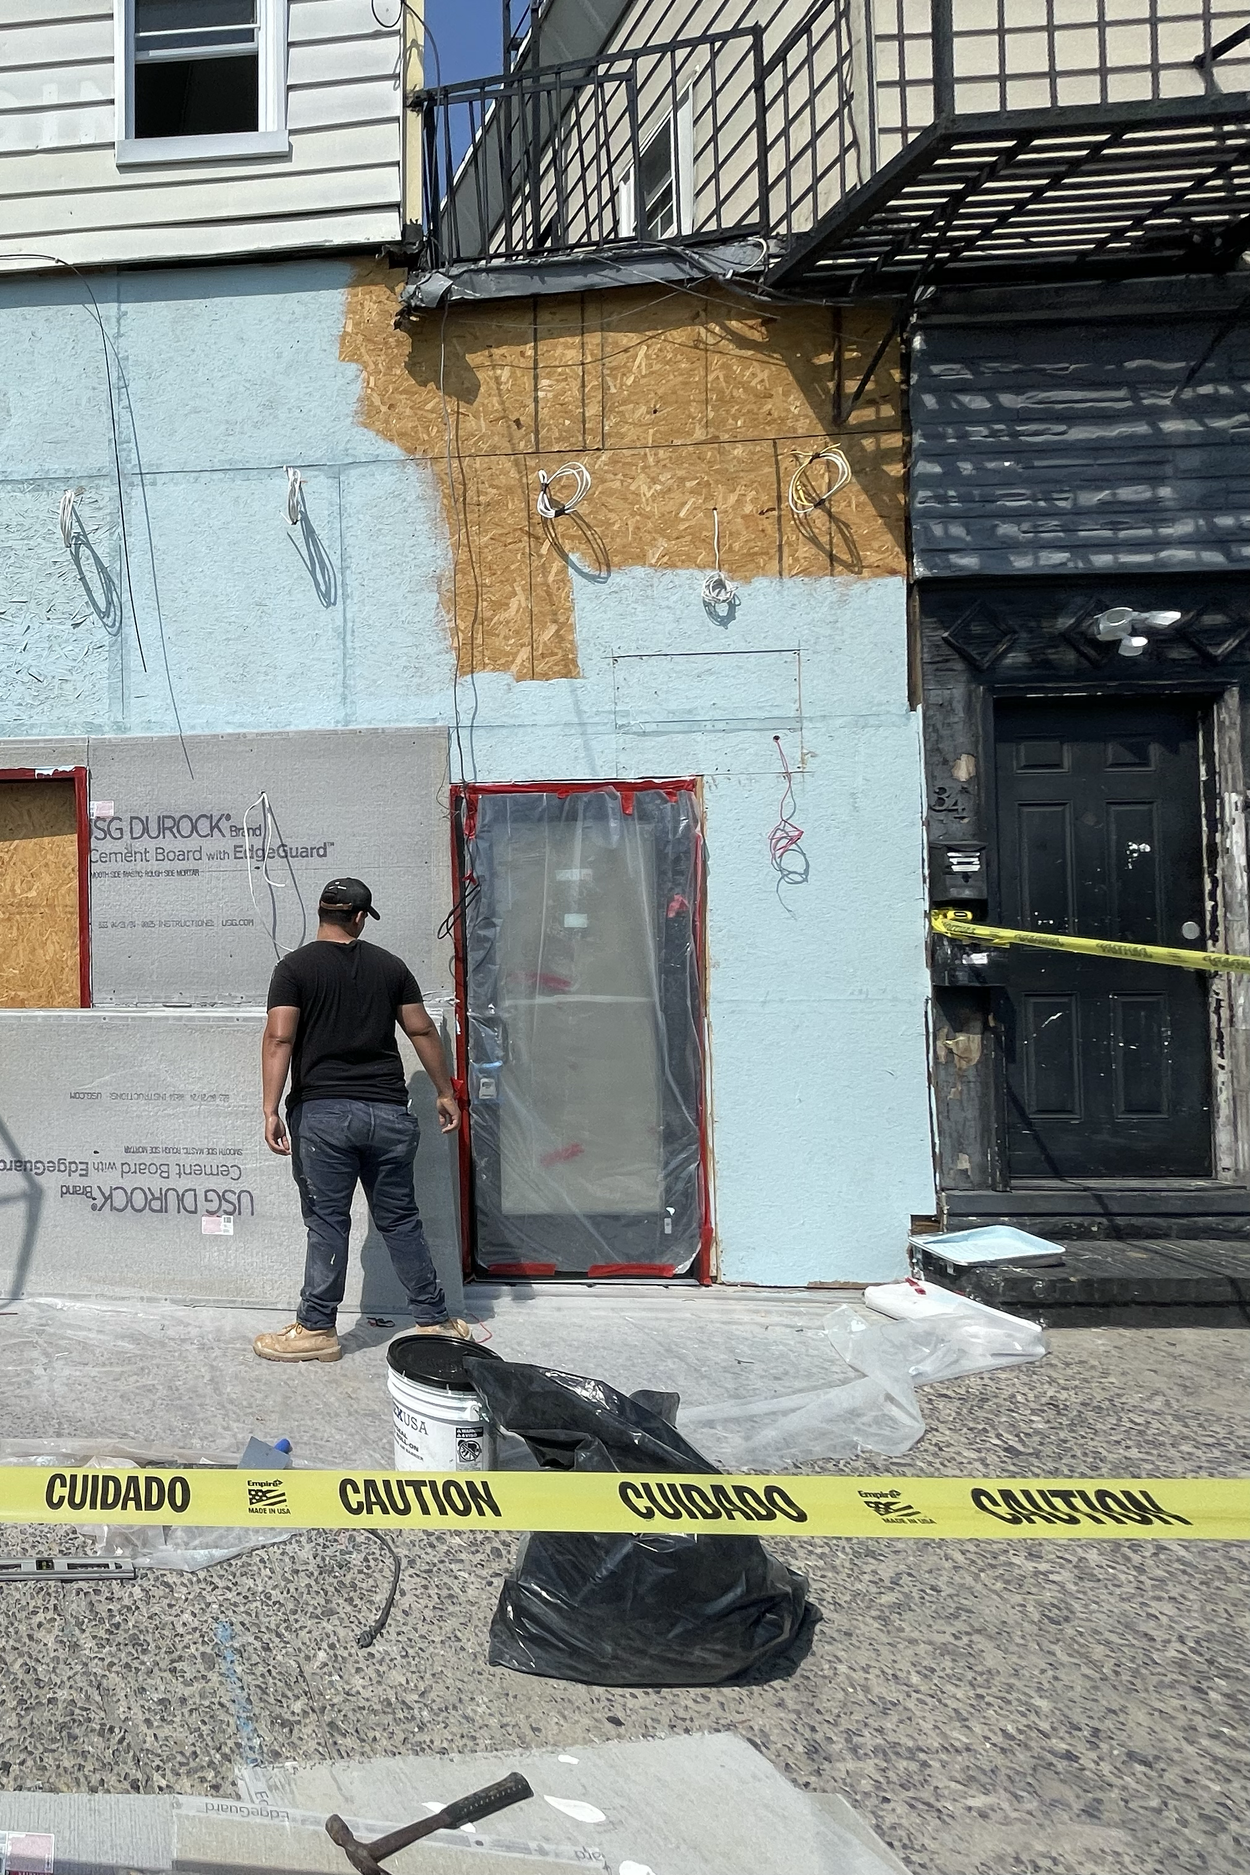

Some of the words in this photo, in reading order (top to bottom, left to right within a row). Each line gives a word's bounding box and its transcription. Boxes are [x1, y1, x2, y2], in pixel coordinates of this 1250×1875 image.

[89, 815, 124, 841] SG
[230, 824, 262, 838] Brand
[155, 845, 202, 862] Board
[206, 850, 230, 861] with
[92, 1161, 118, 1173] with
[120, 1161, 170, 1179] Board
[175, 1163, 242, 1181] Cement
[60, 1184, 93, 1199] Brand
[204, 1188, 255, 1216] USG
[45, 1473, 191, 1513] CUIDADO
[338, 1478, 503, 1517] CAUTION
[617, 1480, 808, 1523] CUIDADO
[970, 1487, 1193, 1527] CAUTION
[205, 1802, 290, 1821] EdgeGuard
